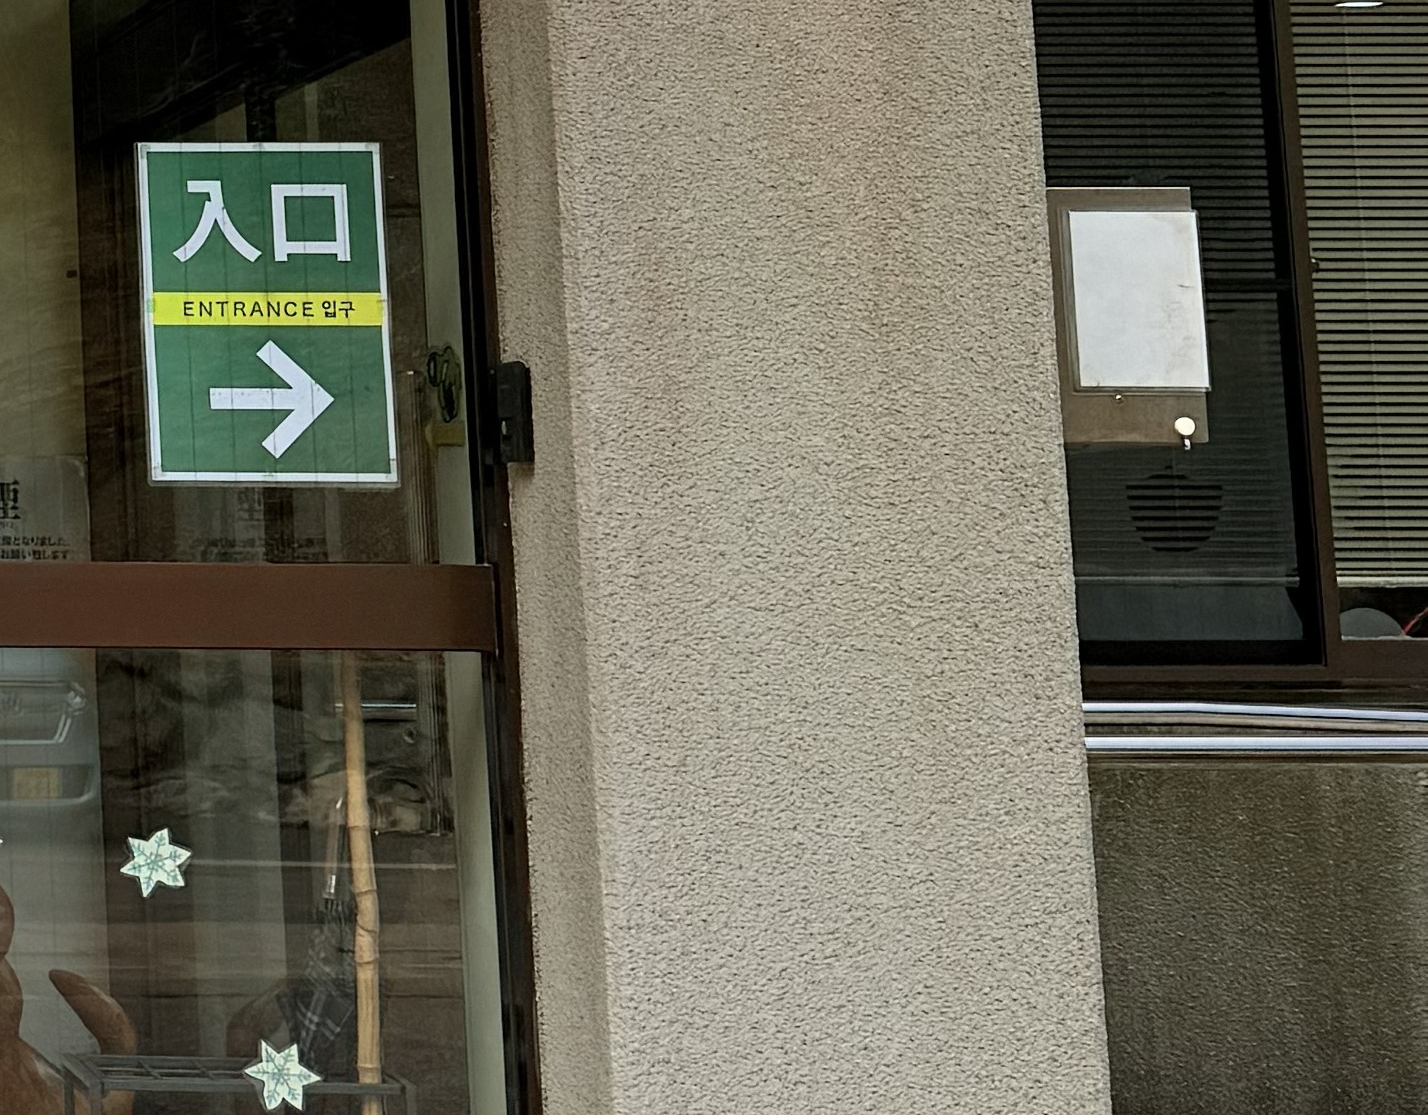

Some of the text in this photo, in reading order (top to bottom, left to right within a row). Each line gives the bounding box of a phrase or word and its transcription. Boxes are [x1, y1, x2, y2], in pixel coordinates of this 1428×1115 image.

[173, 179, 351, 263] 入口
[183, 300, 356, 319] ENTRANCE 입구
